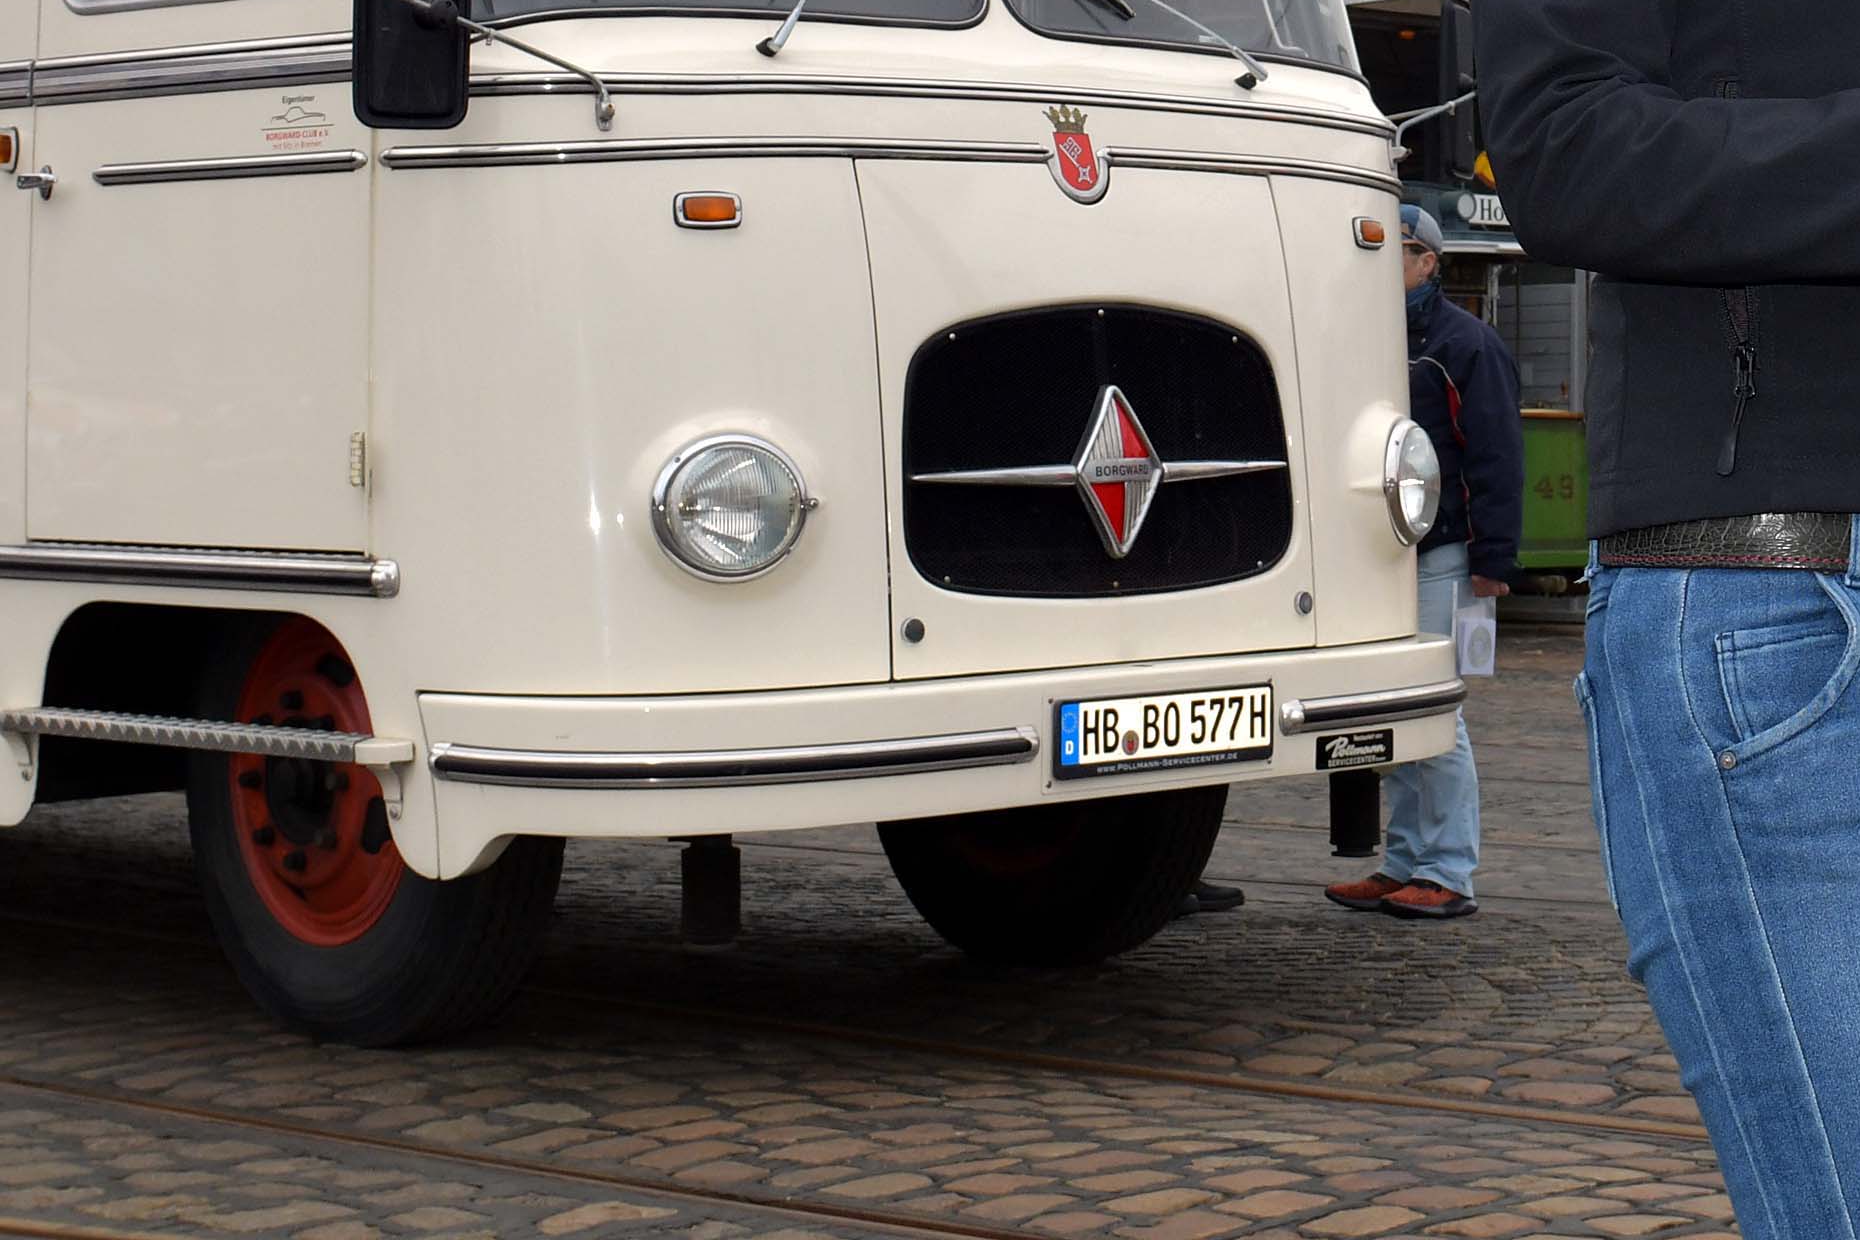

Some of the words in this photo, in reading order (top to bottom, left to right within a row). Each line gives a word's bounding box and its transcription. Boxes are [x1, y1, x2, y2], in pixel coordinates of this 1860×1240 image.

[1480, 198, 1504, 222] Ho
[1095, 463, 1149, 477] BORGWARD
[1065, 741, 1074, 755] D
[1083, 708, 1119, 756] HB
[1143, 701, 1180, 749] BO
[1325, 736, 1387, 759] Pollmann
